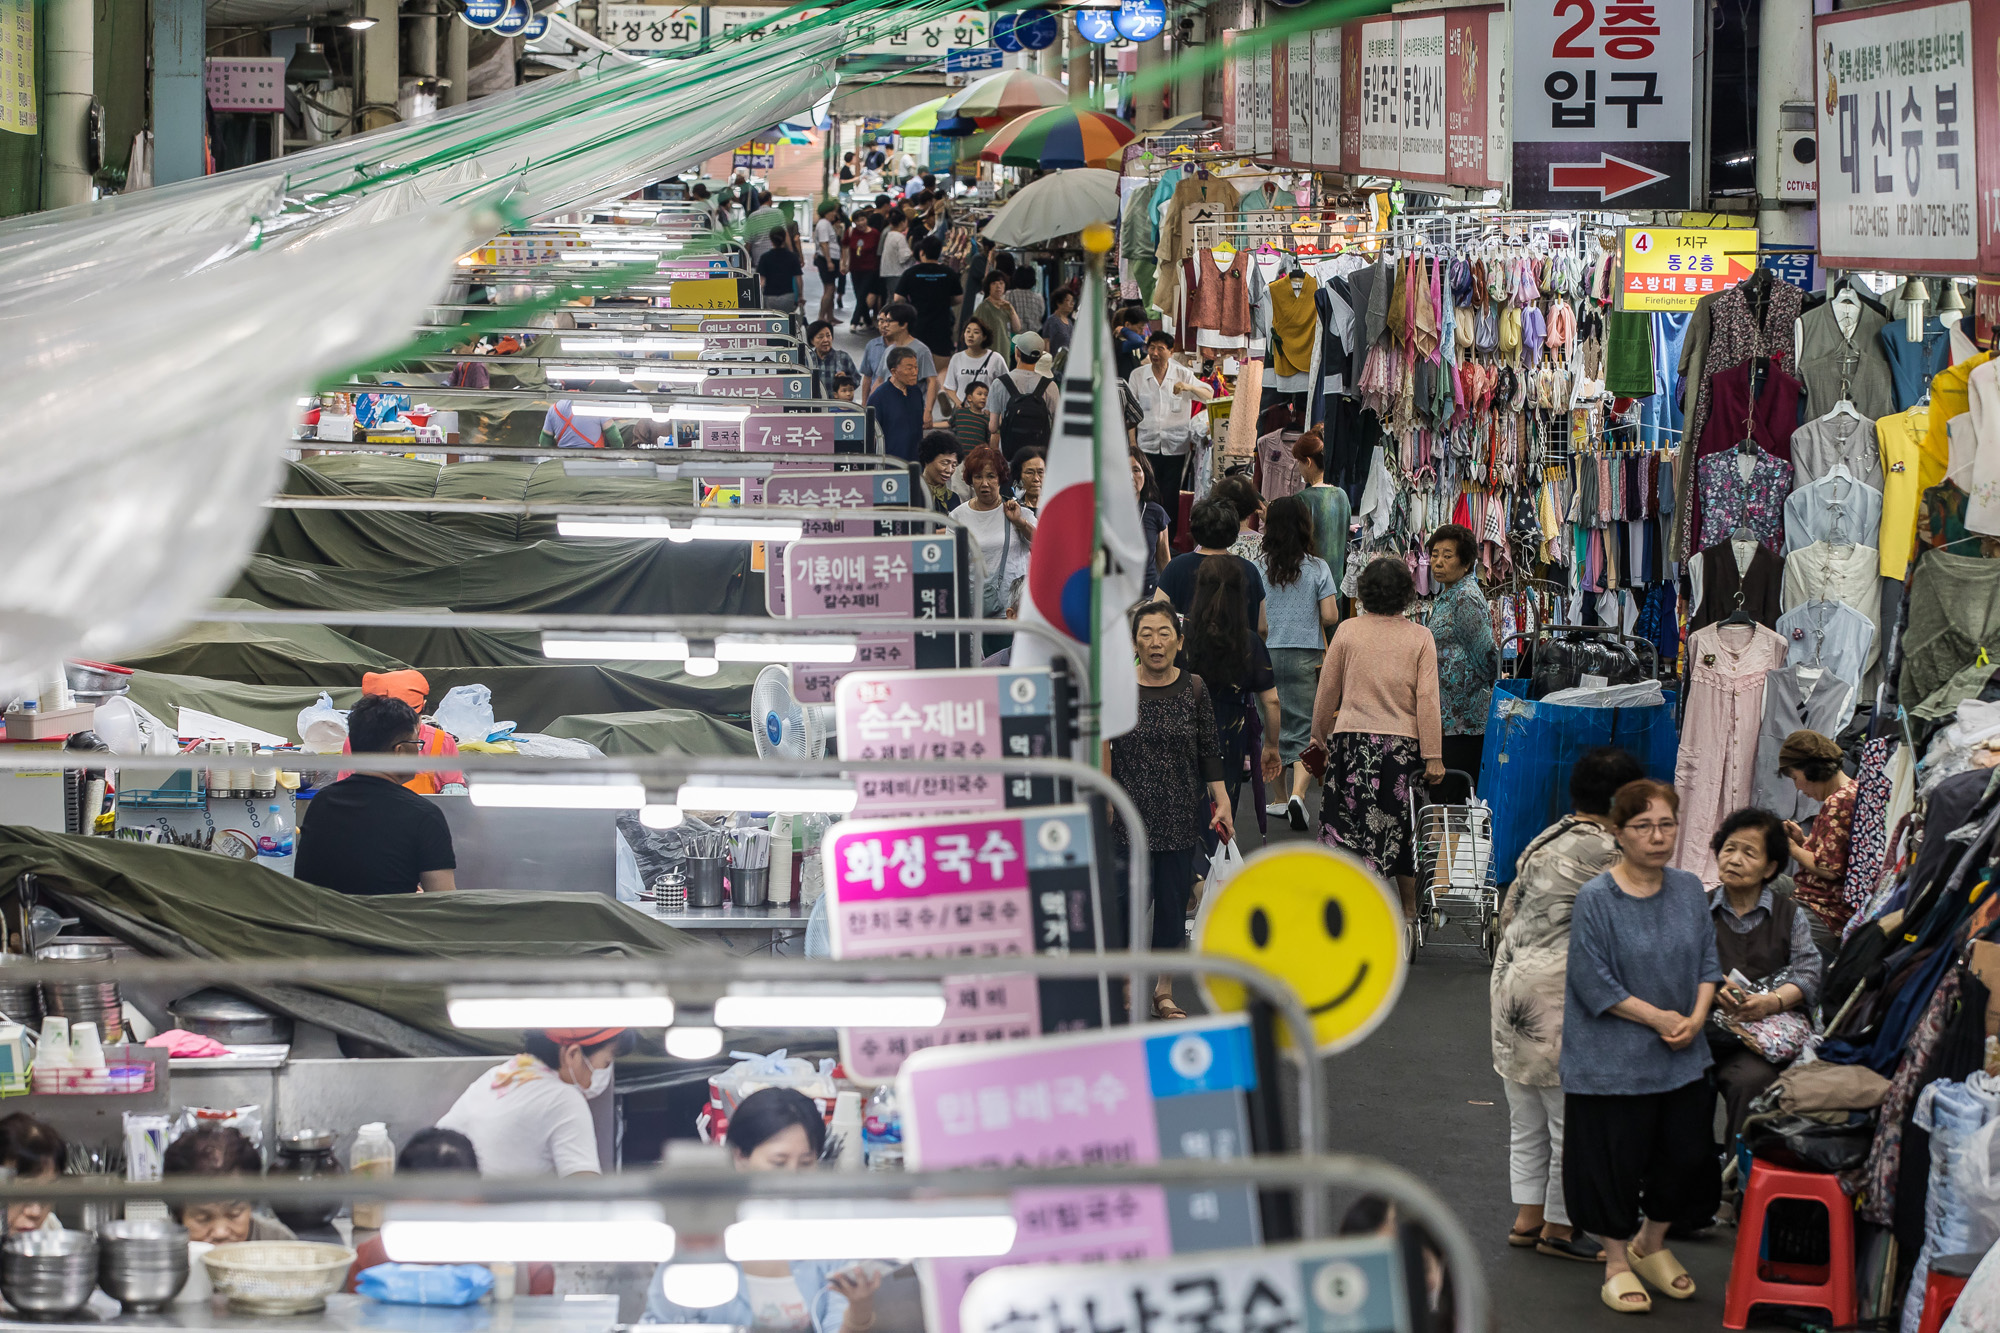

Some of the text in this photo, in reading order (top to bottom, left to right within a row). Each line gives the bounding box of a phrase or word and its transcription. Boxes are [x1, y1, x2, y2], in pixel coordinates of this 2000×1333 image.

[1551, 0, 1661, 60] 2층
[1363, 63, 1398, 127] 동일주단
[1403, 63, 1443, 131] 동일상사
[1543, 69, 1664, 129] 입구
[1838, 81, 1961, 198] 대신승복
[1635, 234, 1709, 251] 4 1지구
[1666, 254, 1715, 272] 동 2층
[1629, 275, 1715, 292] 소방대 통로
[1645, 296, 1687, 307] Firefighter
[773, 323, 779, 332] 6
[792, 381, 799, 391] 6
[710, 421, 852, 447] 콩국수 7번 국수 6
[884, 482, 894, 494] 6
[796, 554, 866, 586] 기훈이네
[872, 553, 908, 584] 국수
[926, 546, 937, 560] 6
[859, 646, 902, 662] 칼국수
[856, 699, 986, 741] 손수제비
[931, 829, 1019, 884] 국수
